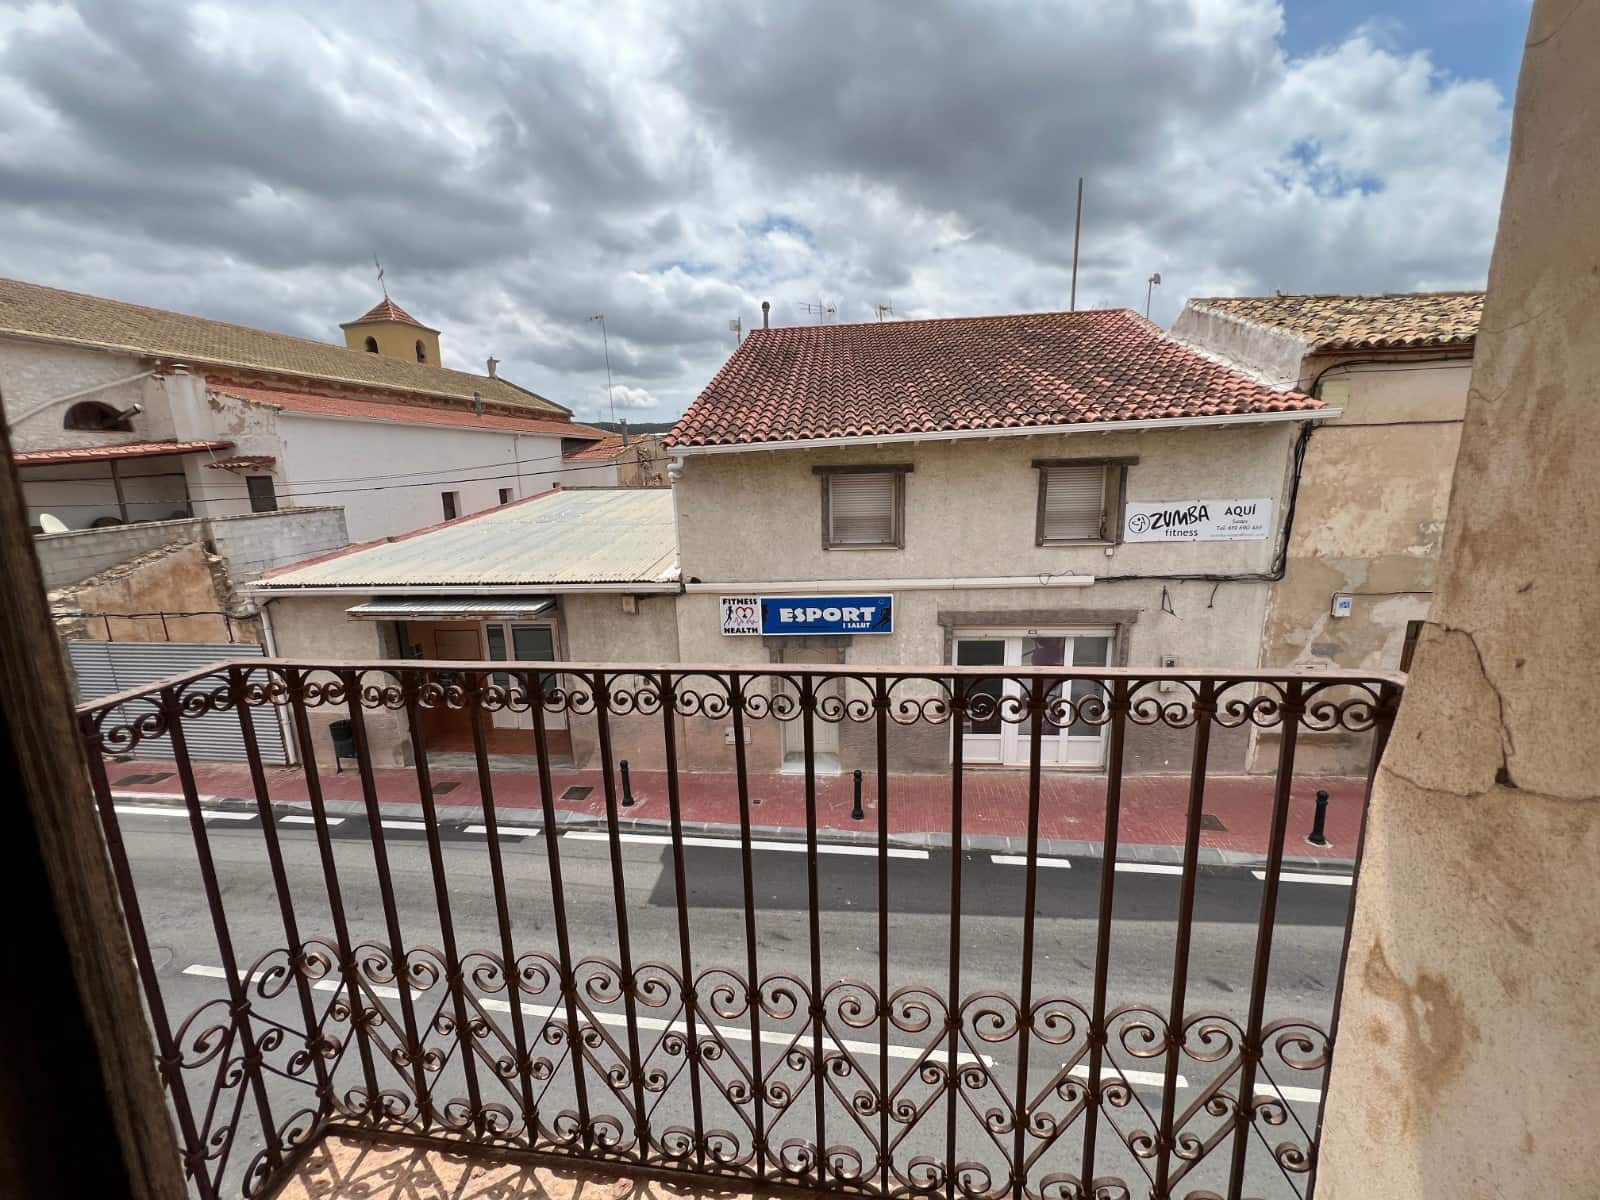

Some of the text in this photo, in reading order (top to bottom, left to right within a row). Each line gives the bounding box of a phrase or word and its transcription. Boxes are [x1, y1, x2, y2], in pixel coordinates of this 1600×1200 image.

[1150, 505, 1210, 530] ZUMBA
[1224, 504, 1257, 517] AQUÍ
[1165, 528, 1199, 537] fitness
[779, 607, 876, 623] ESPORT
